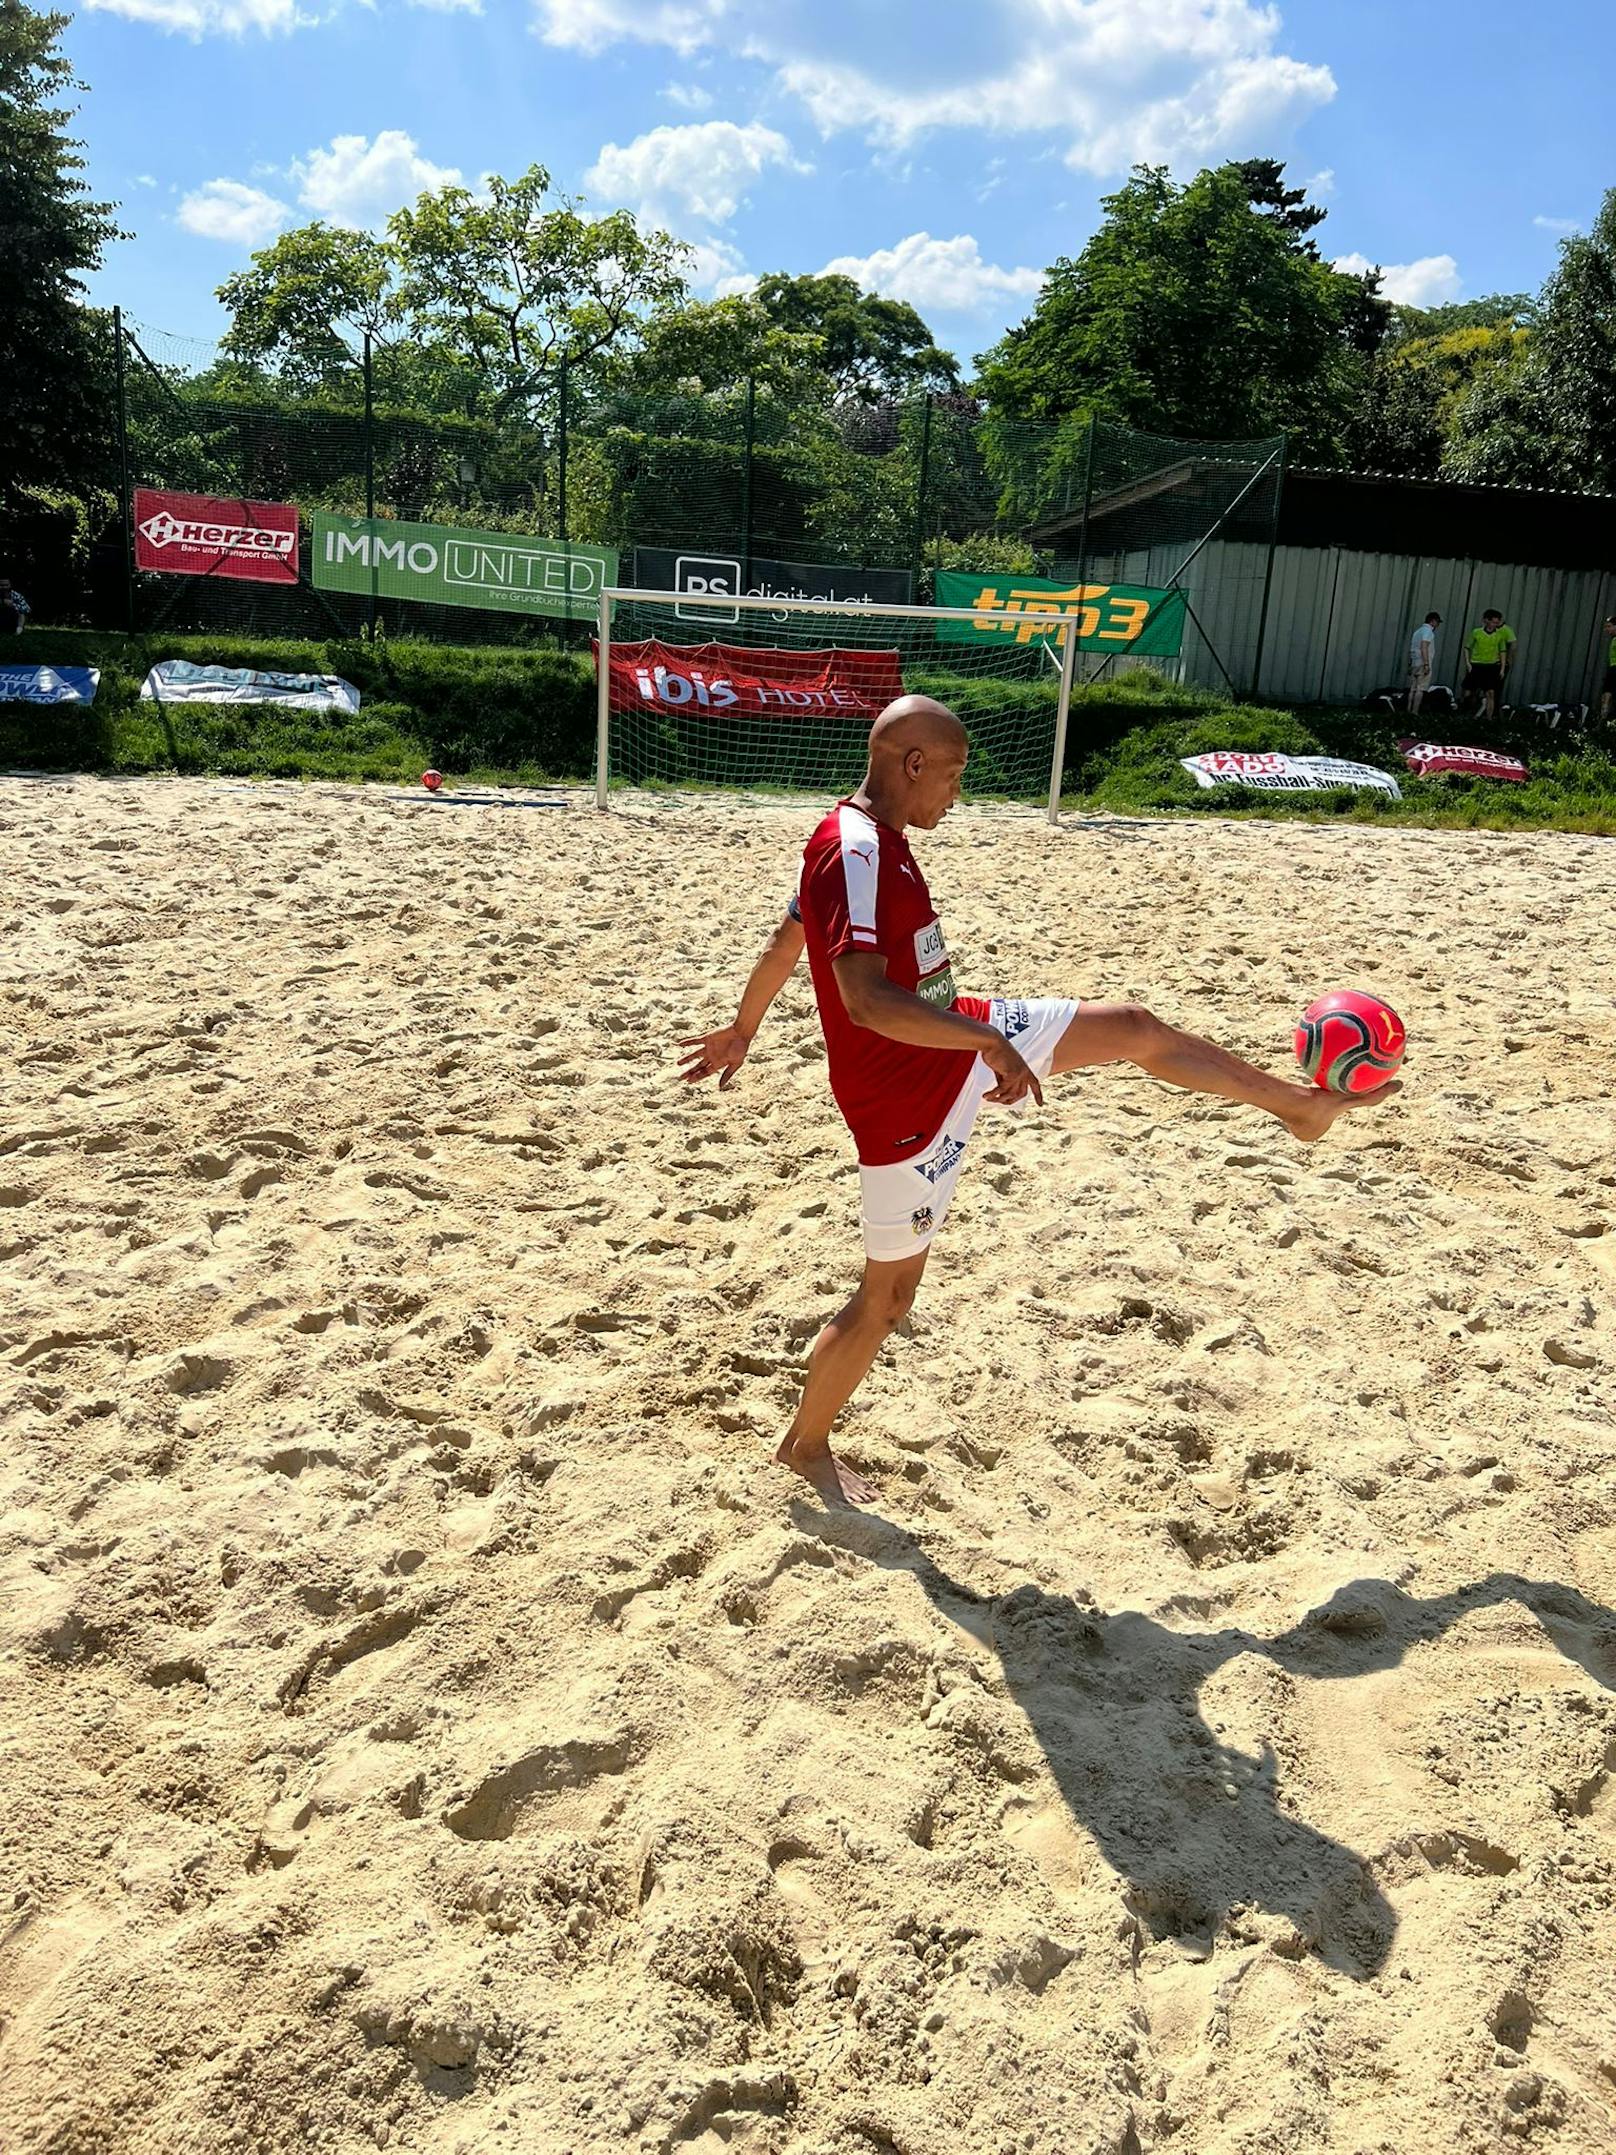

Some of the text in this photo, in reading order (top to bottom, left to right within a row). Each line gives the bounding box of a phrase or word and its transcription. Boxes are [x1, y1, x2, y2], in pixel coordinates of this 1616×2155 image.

[182, 524, 290, 548] Herzer
[181, 543, 288, 561] Bau- und Transport GmbH
[326, 531, 594, 592] IMMO UNITED
[489, 590, 508, 600] Ihre
[635, 666, 871, 708] ibis HOTEL
[1441, 746, 1518, 766] Herzer
